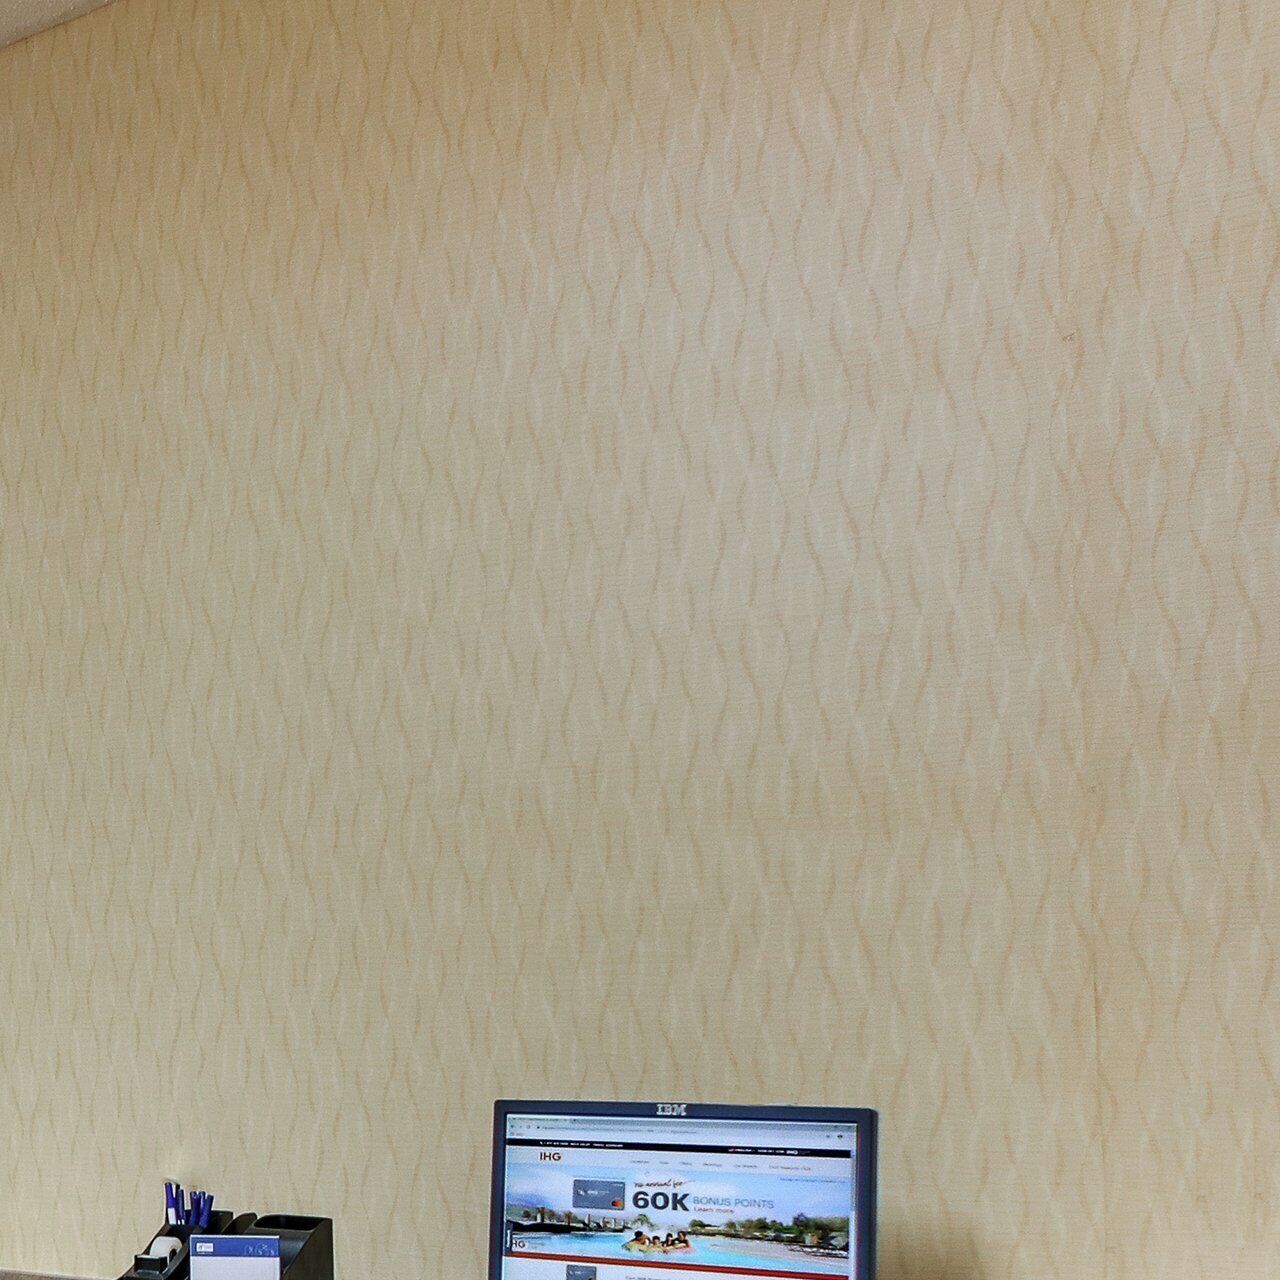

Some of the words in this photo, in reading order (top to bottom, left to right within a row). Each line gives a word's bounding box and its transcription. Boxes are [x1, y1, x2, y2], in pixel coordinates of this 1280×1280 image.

[656, 1103, 687, 1116] IBM
[539, 1152, 562, 1161] IHG
[632, 1189, 690, 1212] 60K
[692, 1195, 731, 1207] BONUS
[734, 1198, 775, 1210] POINTS
